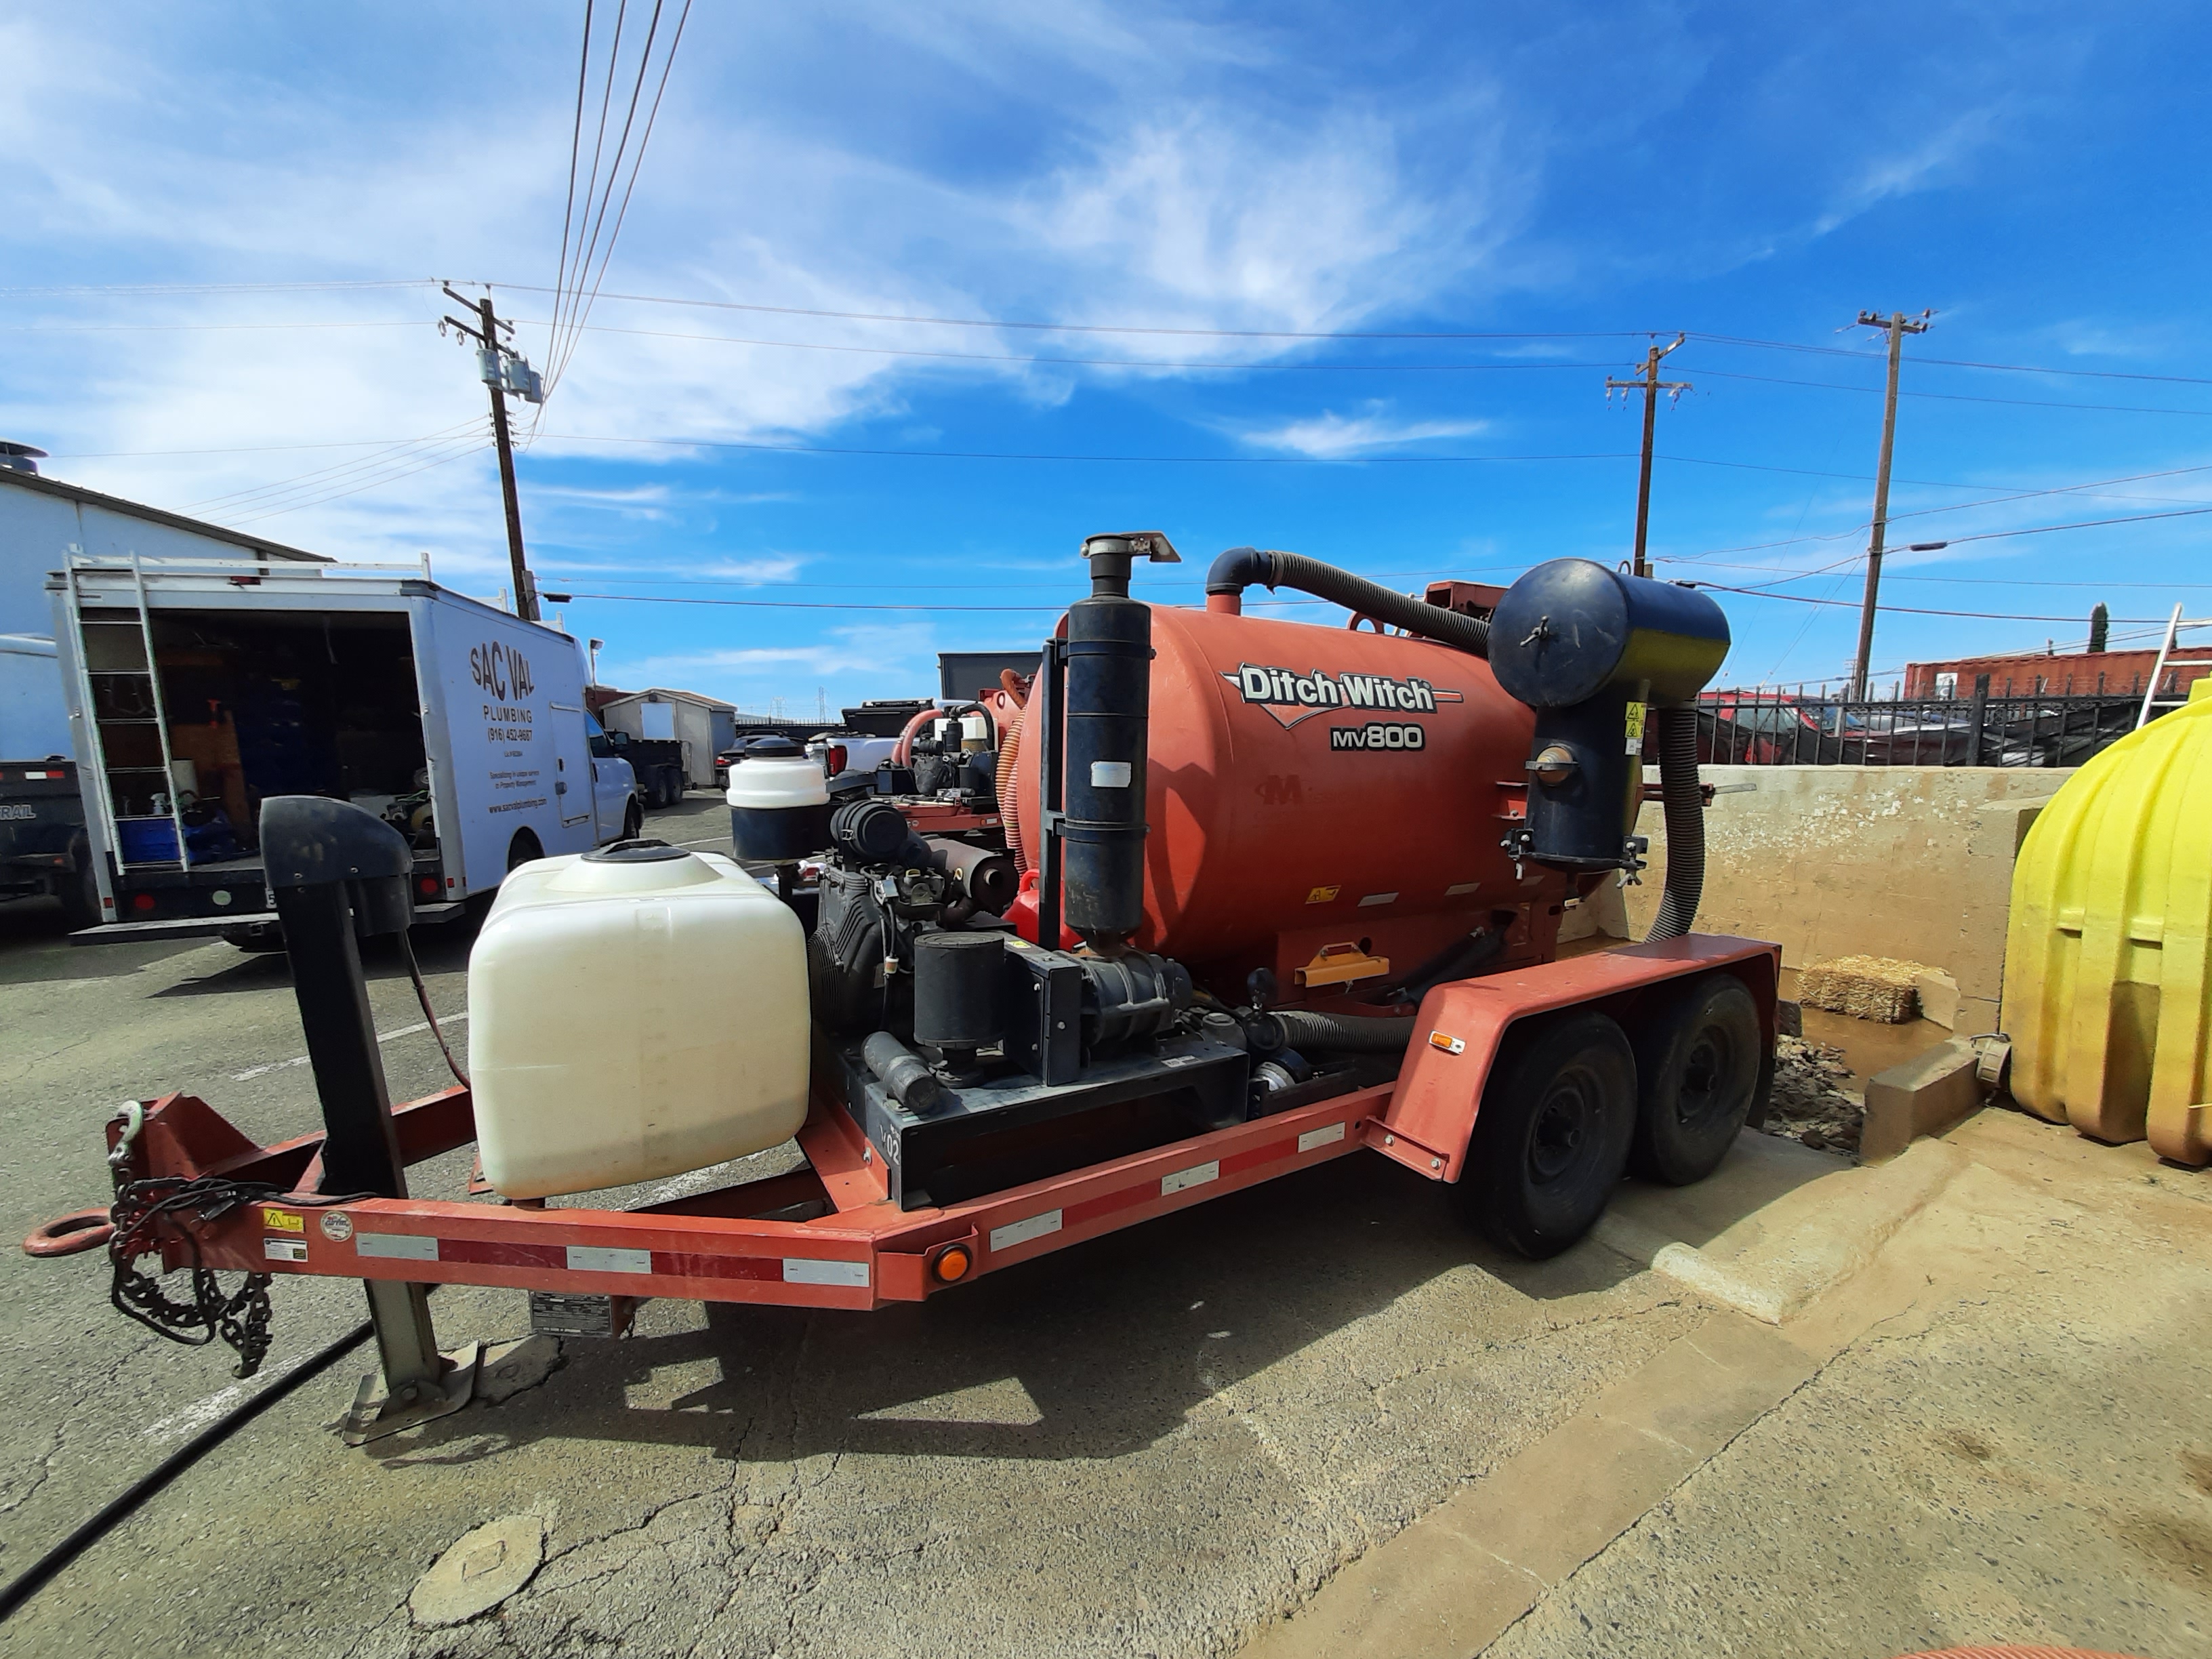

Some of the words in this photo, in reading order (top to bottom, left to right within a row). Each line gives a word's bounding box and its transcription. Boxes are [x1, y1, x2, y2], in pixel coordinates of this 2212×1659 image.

[470, 641, 506, 701] SAC
[506, 645, 535, 701] VAL
[1242, 668, 1338, 705] Ditch
[1341, 675, 1435, 712] Witch
[483, 705, 533, 724] PLUMBING
[488, 727, 505, 743] (916)
[1332, 725, 1422, 749] MV800
[0, 804, 37, 820] RAIL
